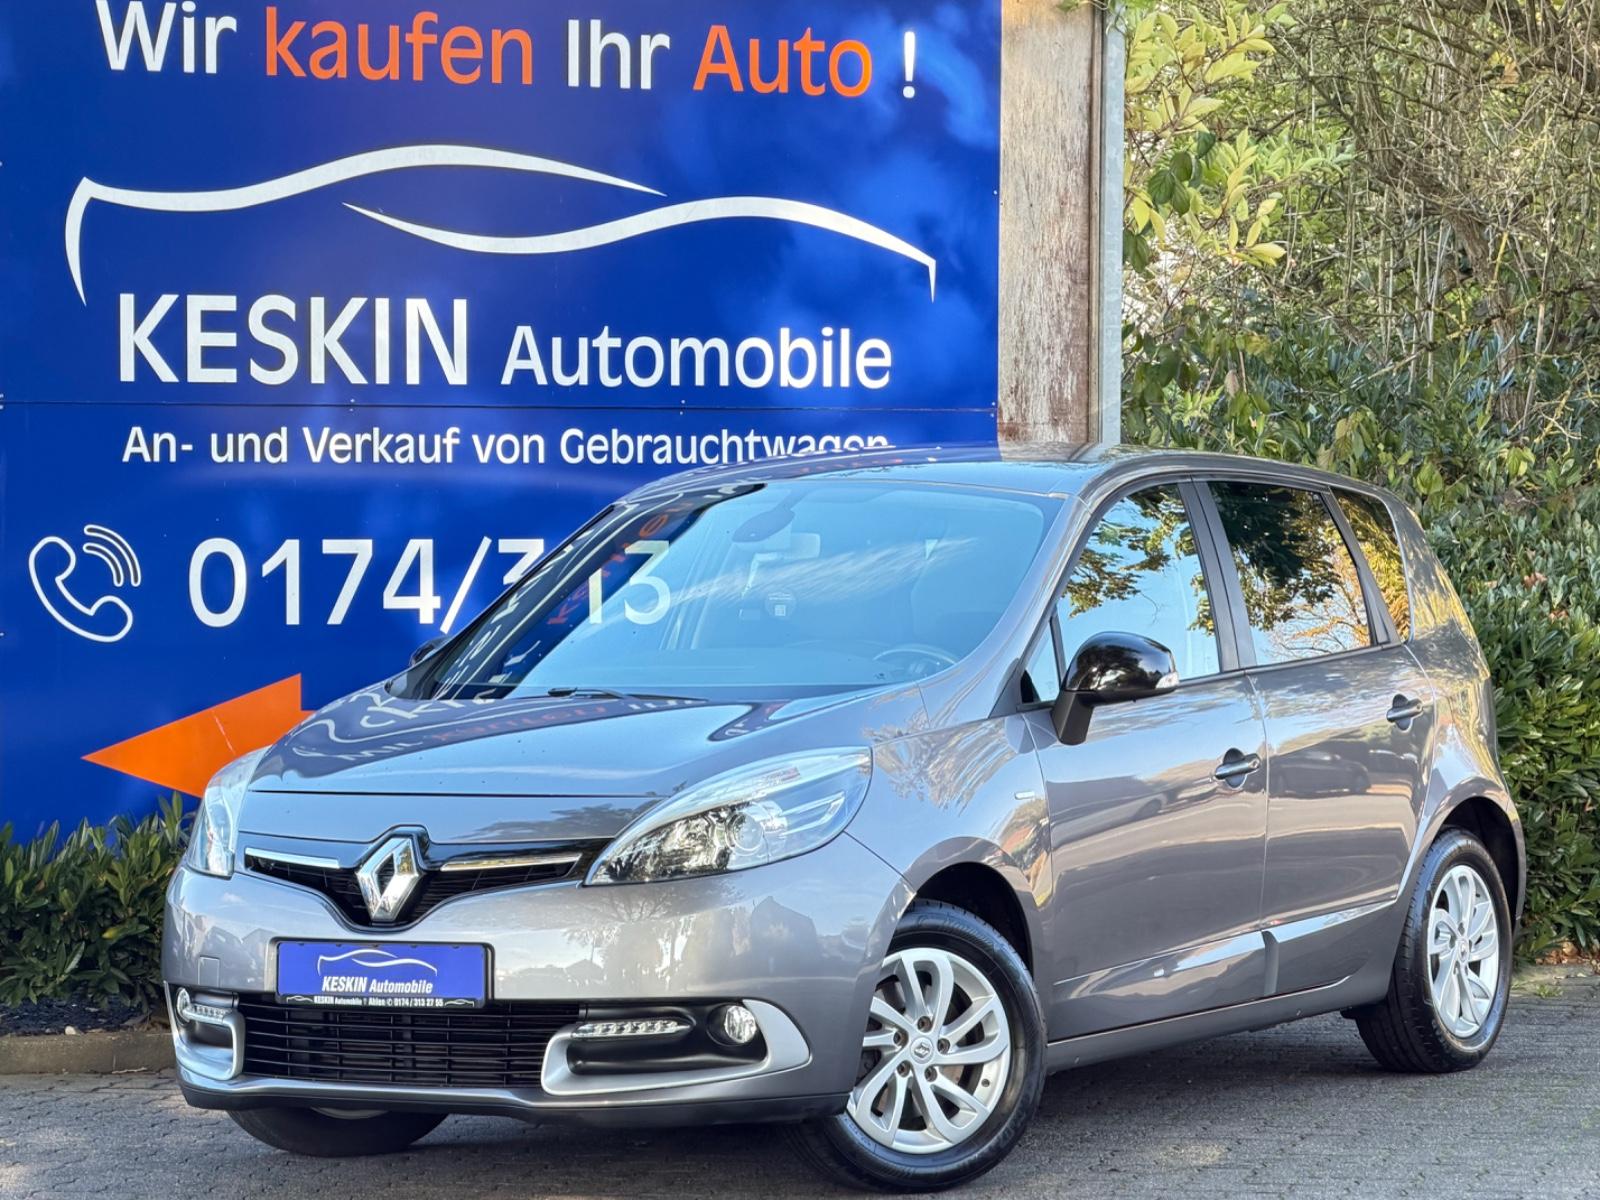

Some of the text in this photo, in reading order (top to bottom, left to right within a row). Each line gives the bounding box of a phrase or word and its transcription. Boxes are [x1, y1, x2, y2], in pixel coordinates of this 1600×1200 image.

[96, 0, 916, 99] Wir kaufen Ihr Auto !
[119, 293, 892, 390] KESKIN Automobile
[122, 426, 193, 463] An-
[210, 427, 288, 463] und
[302, 426, 461, 464] Verkauf
[472, 433, 545, 465] von
[322, 976, 433, 994] KESKIN Automobile
